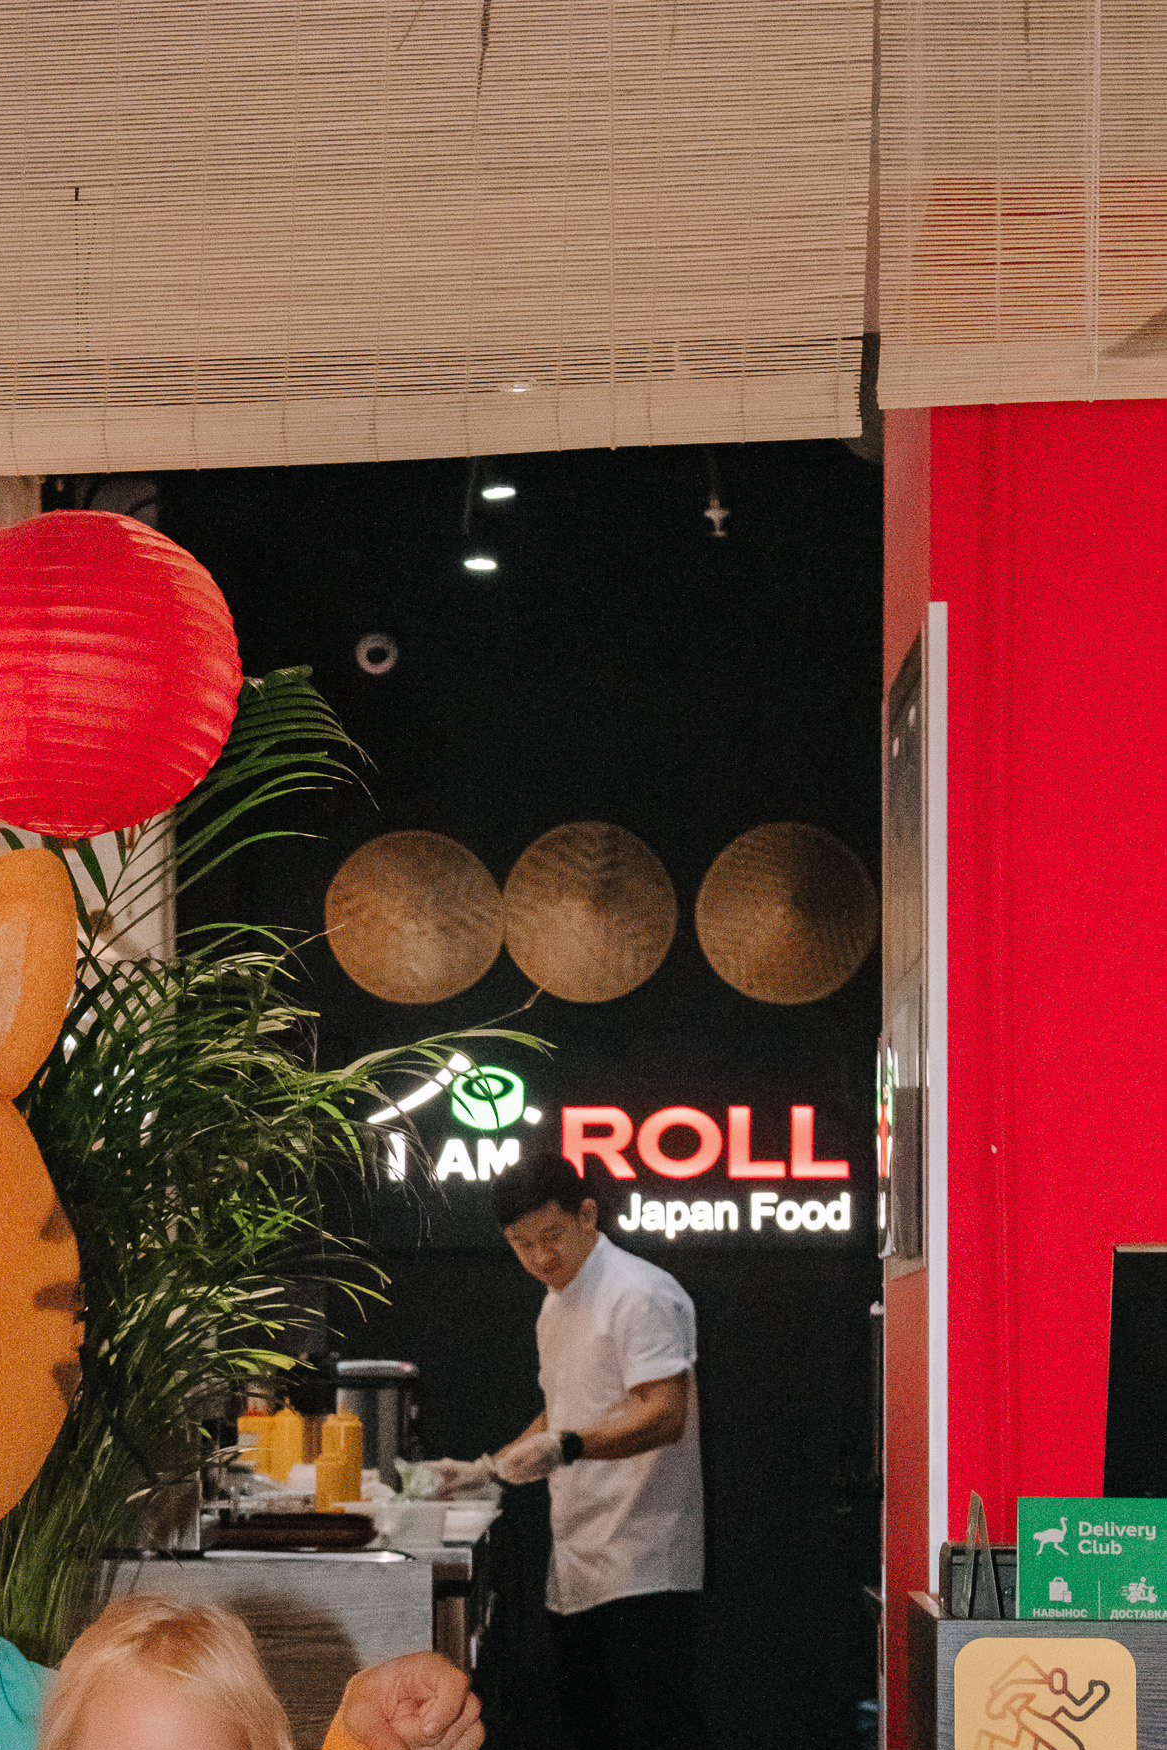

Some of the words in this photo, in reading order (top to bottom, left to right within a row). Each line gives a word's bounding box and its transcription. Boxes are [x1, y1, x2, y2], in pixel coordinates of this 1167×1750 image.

[388, 1132, 406, 1181] I
[435, 1138, 520, 1181] AM
[561, 1105, 850, 1179] ROLL
[618, 1192, 739, 1239] Japan
[750, 1191, 851, 1231] Food
[1078, 1521, 1156, 1540] Delivery
[1078, 1540, 1122, 1555] Club
